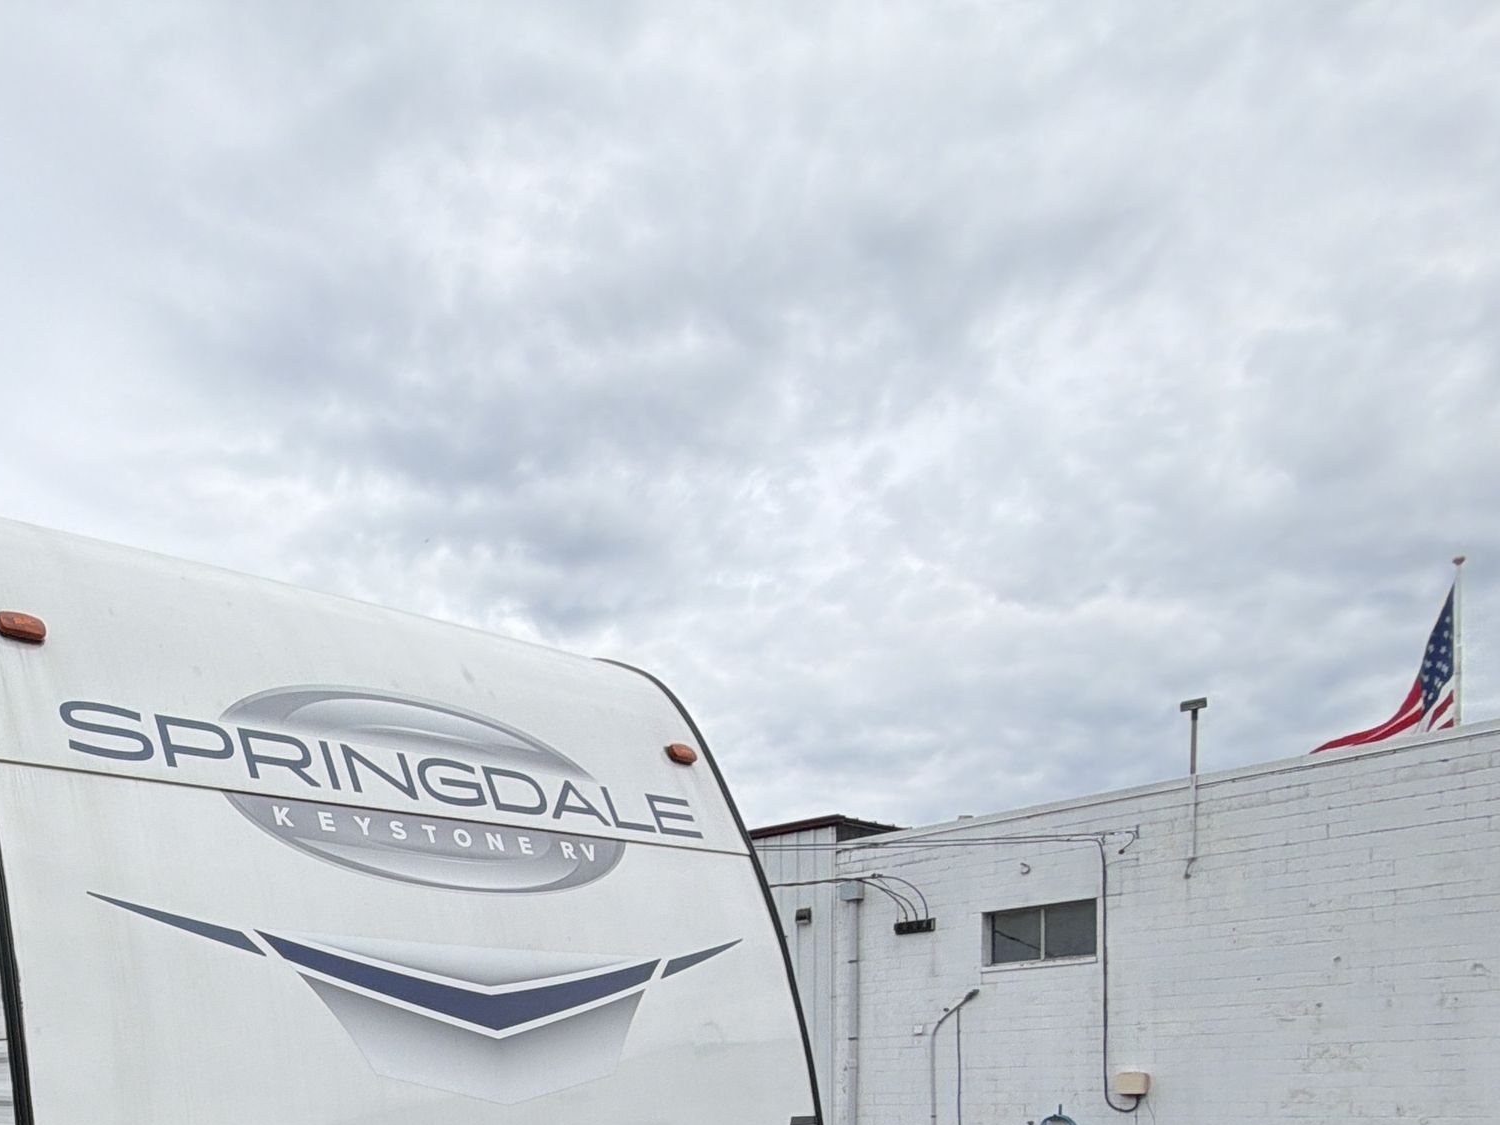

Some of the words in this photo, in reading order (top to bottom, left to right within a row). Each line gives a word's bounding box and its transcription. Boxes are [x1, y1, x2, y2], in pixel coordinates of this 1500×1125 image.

[60, 700, 704, 840] SPRINGDALE
[271, 805, 535, 856] KEYSTONE
[560, 841, 596, 862] RV
